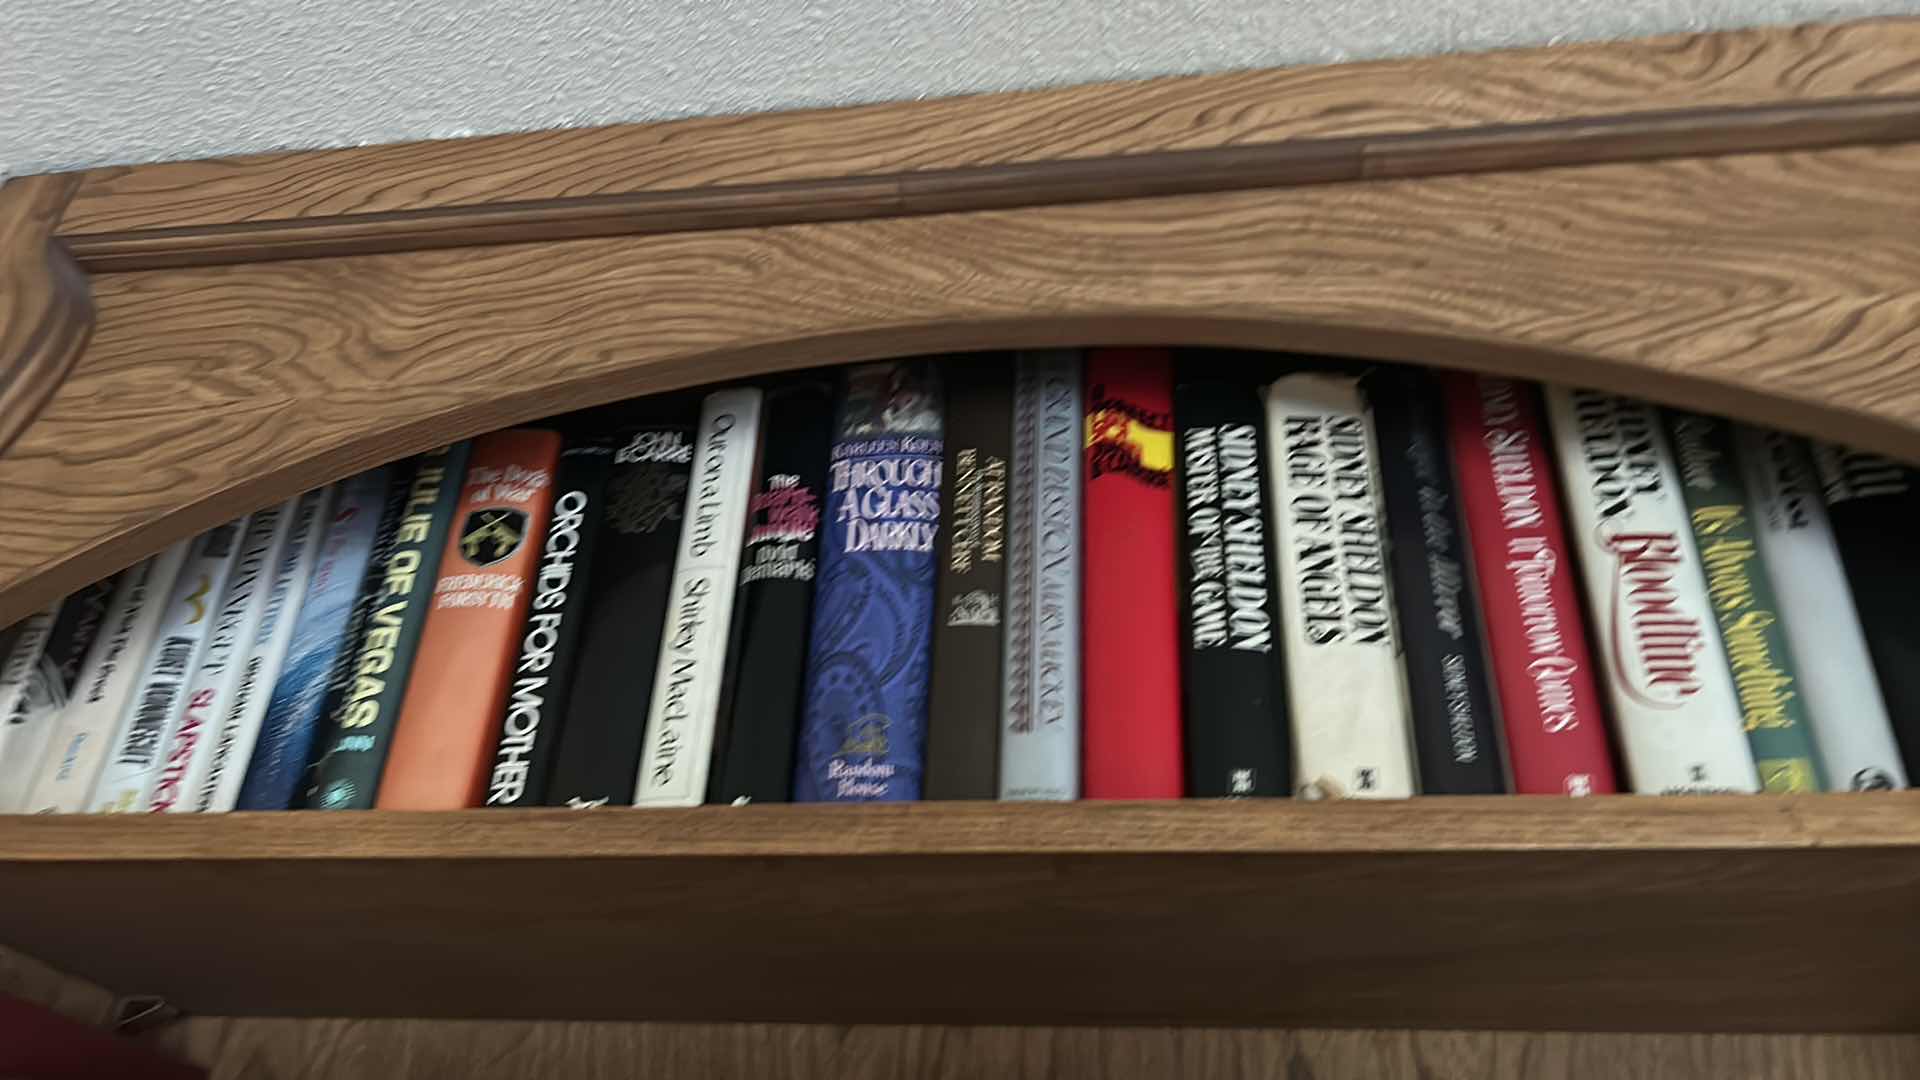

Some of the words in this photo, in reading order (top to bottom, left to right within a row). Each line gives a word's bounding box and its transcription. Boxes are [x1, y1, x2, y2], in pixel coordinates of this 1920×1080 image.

[830, 458, 944, 492] THROUGH
[1183, 426, 1222, 509] MASTER
[1217, 423, 1262, 516] SIDNEY
[1284, 415, 1333, 489] RAGE
[1325, 415, 1371, 507] SIDNEY
[1483, 428, 1543, 529] SHELDON
[836, 491, 861, 523] A
[861, 488, 942, 520] GLASS
[843, 519, 941, 553] DARKLY
[1187, 506, 1224, 541] OF
[1289, 492, 1335, 532] OF
[383, 549, 422, 597] OF
[532, 490, 589, 611] ORCHIDS
[1191, 538, 1225, 582] THE
[1223, 513, 1273, 653] SHELDON
[1335, 509, 1390, 647] SHELDON
[1191, 579, 1229, 650] GAME
[1296, 540, 1347, 647] ANGELS
[1604, 531, 1704, 696] Bloodline
[340, 598, 409, 729] VEGAS
[517, 611, 563, 674] FOR
[486, 676, 549, 807] MOTHER
[828, 759, 896, 781] Random
[836, 779, 890, 798] House
